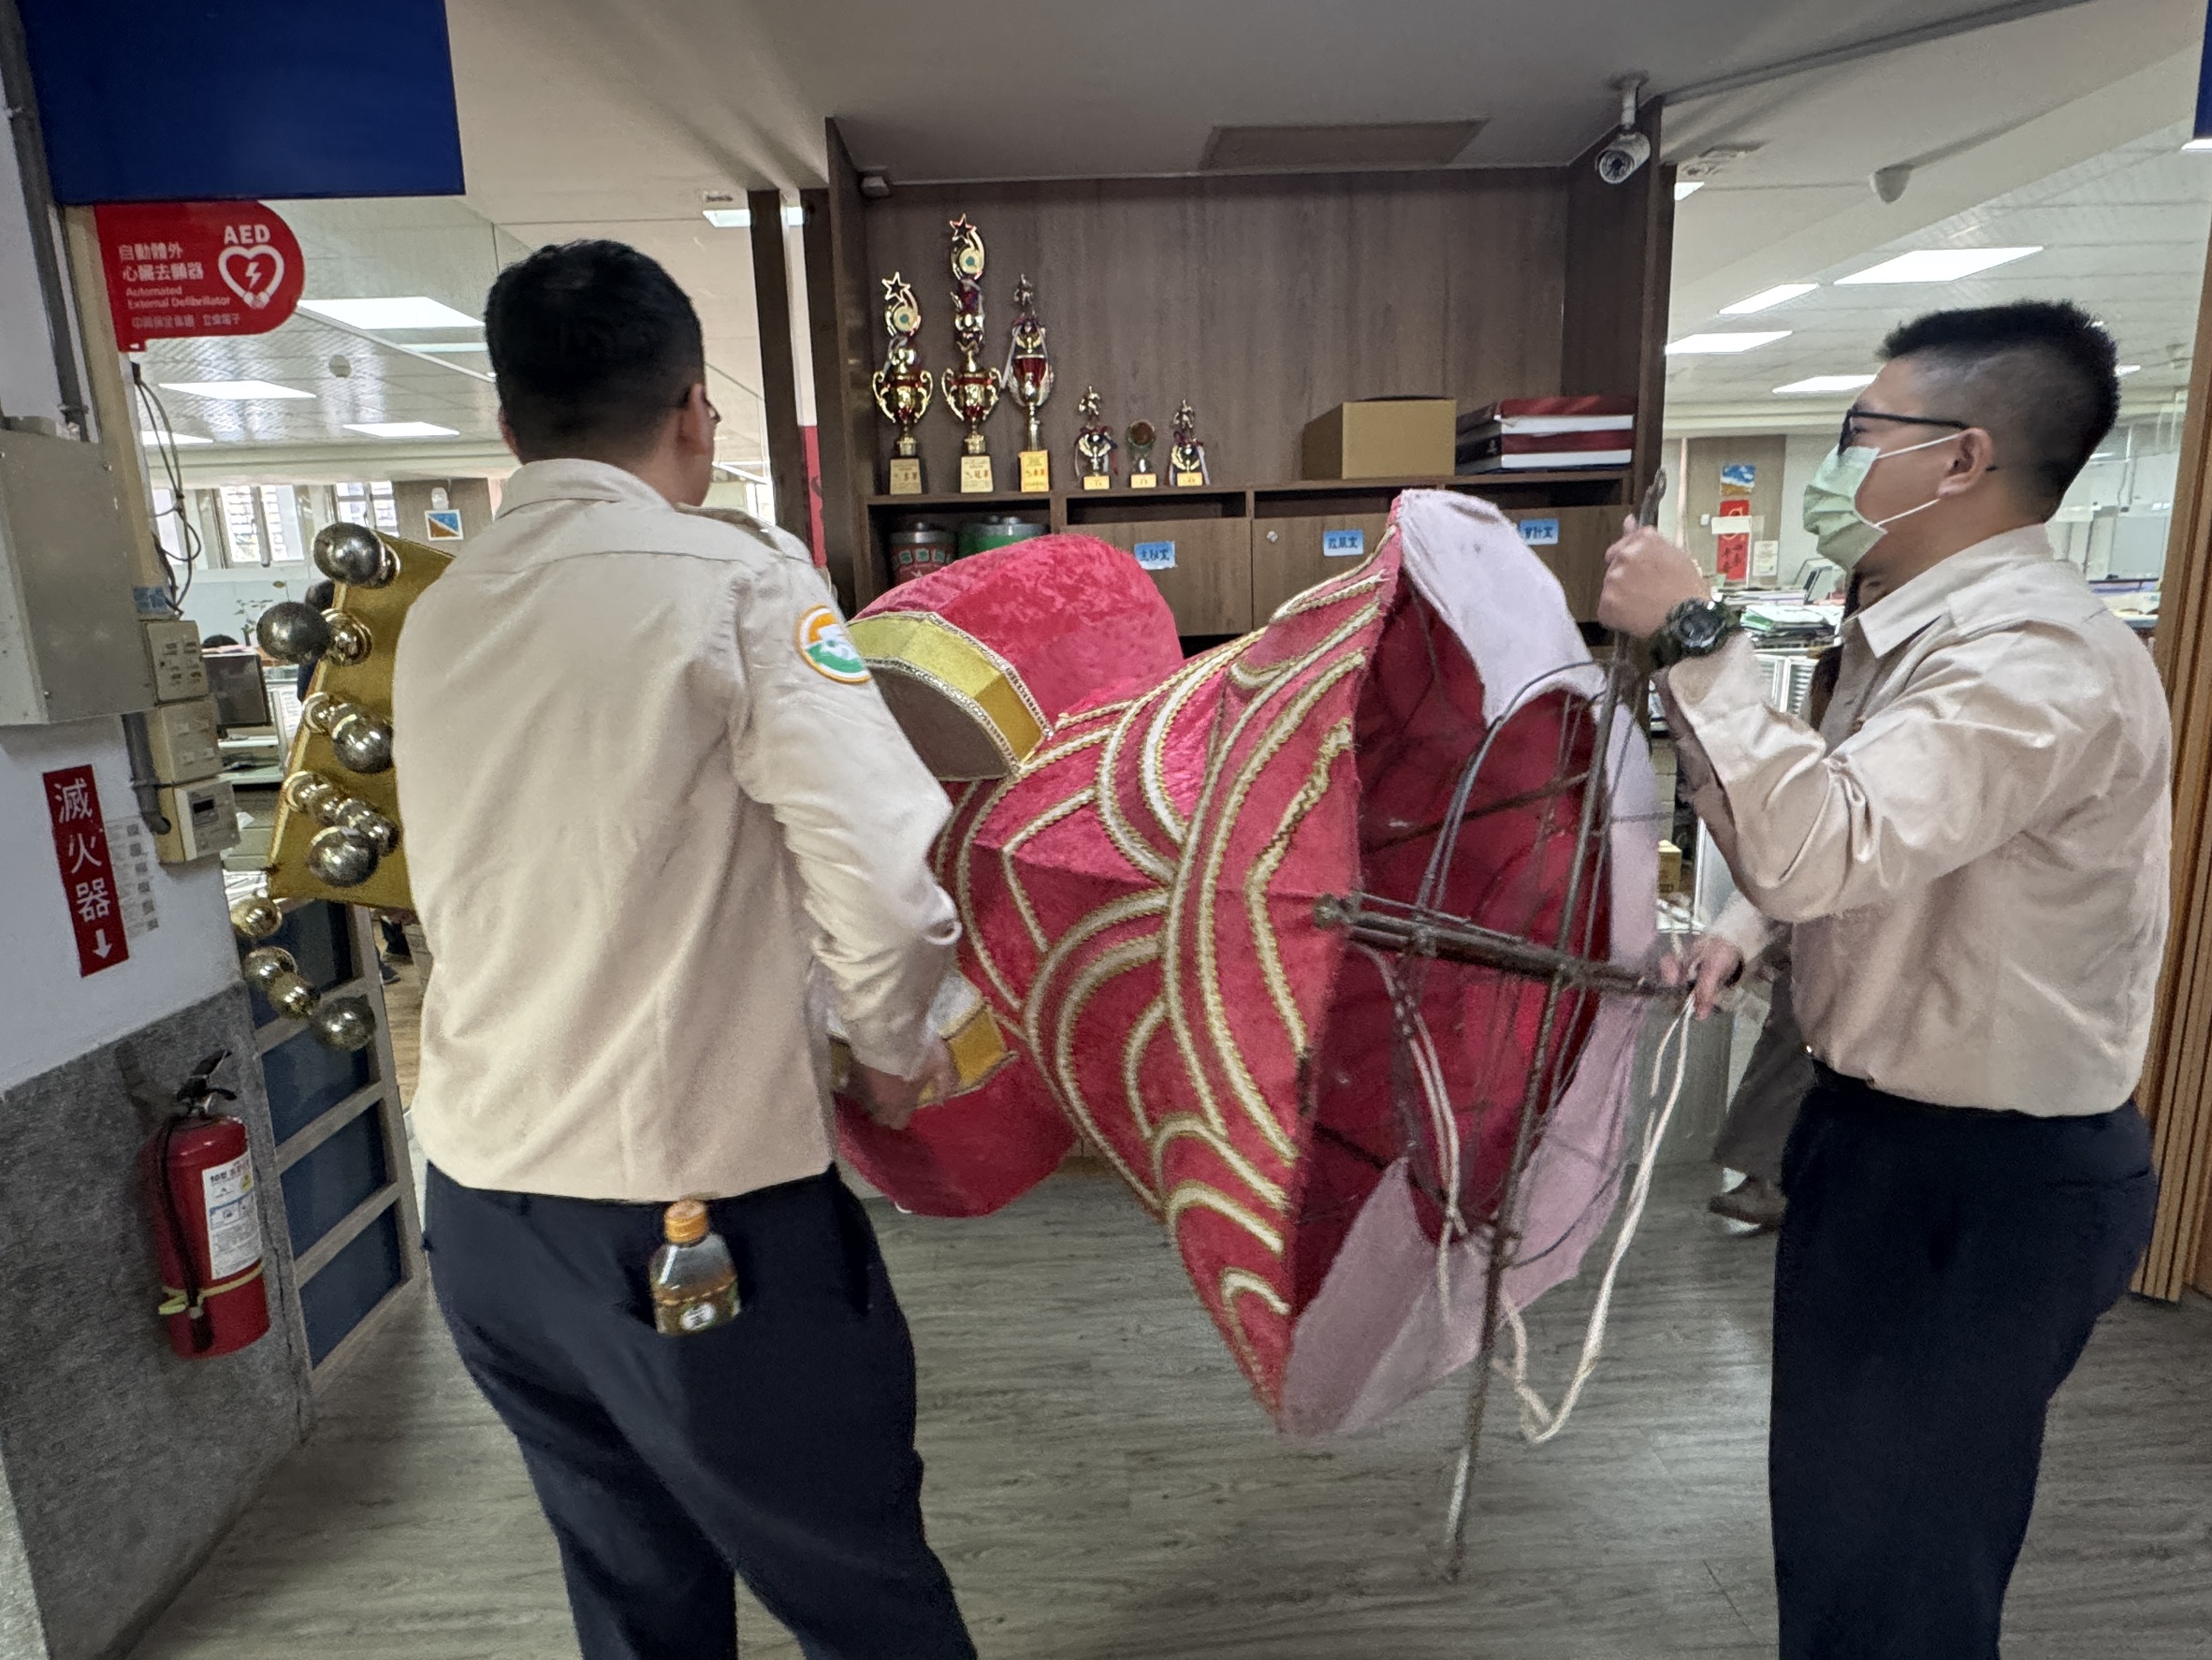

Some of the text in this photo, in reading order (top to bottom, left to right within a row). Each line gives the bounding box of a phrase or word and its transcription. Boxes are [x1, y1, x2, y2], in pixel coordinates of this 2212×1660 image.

[224, 224, 271, 245] AED
[118, 241, 183, 261] 自動體外
[123, 262, 204, 282] 心臟去顫器
[125, 286, 182, 297] Automated
[127, 296, 231, 310] External Defibrillator
[53, 778, 110, 924] 滅火器
